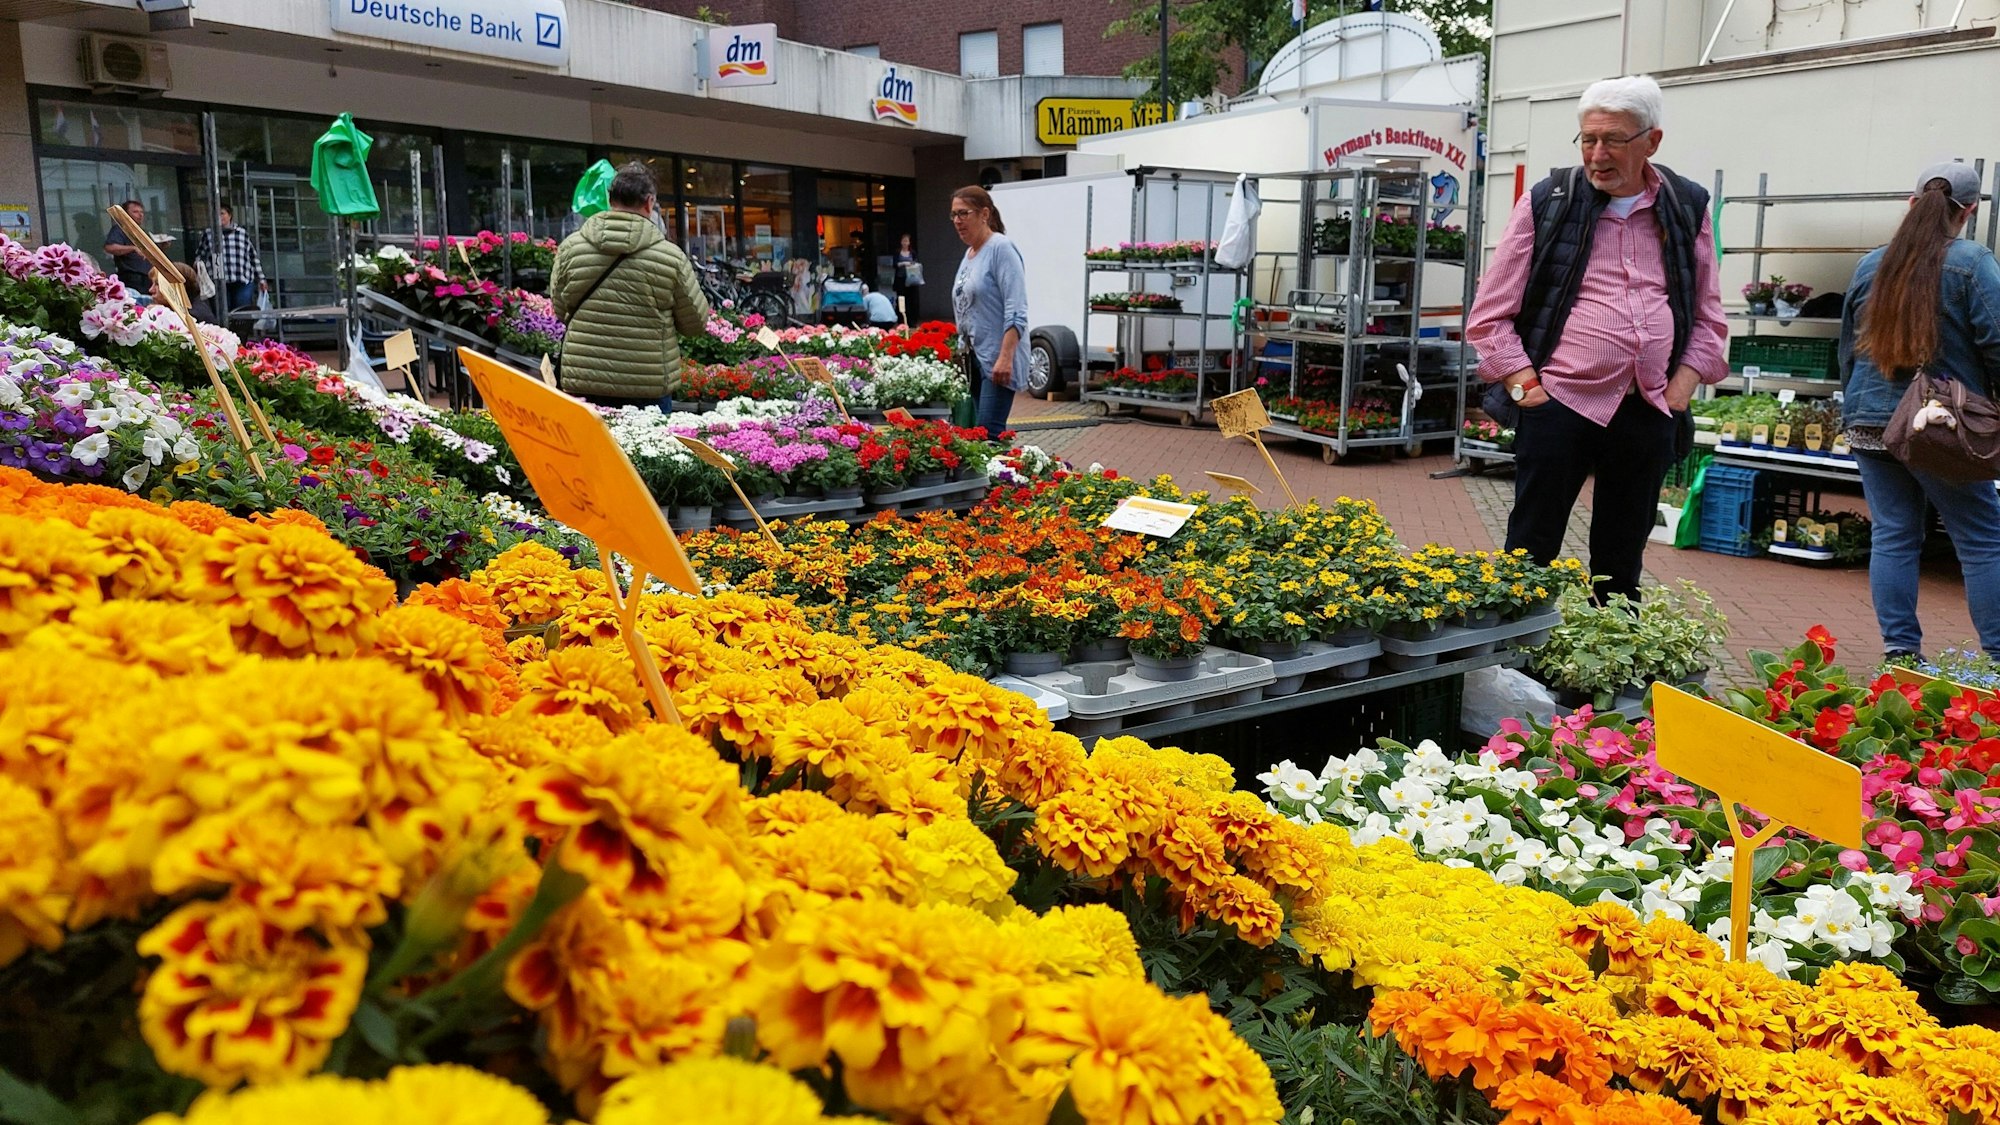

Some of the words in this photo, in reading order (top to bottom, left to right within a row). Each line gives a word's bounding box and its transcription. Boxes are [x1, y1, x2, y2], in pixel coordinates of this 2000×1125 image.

[351, 0, 462, 31] Deutsche
[470, 13, 523, 43] Bank
[726, 35, 761, 63] dm
[883, 67, 913, 103] dm
[1047, 107, 1123, 136] Mamma
[1067, 107, 1101, 115] Pizzeria
[1385, 127, 1444, 155] Backfisch
[1444, 142, 1468, 171] XXL
[474, 371, 574, 447] Rosmarin
